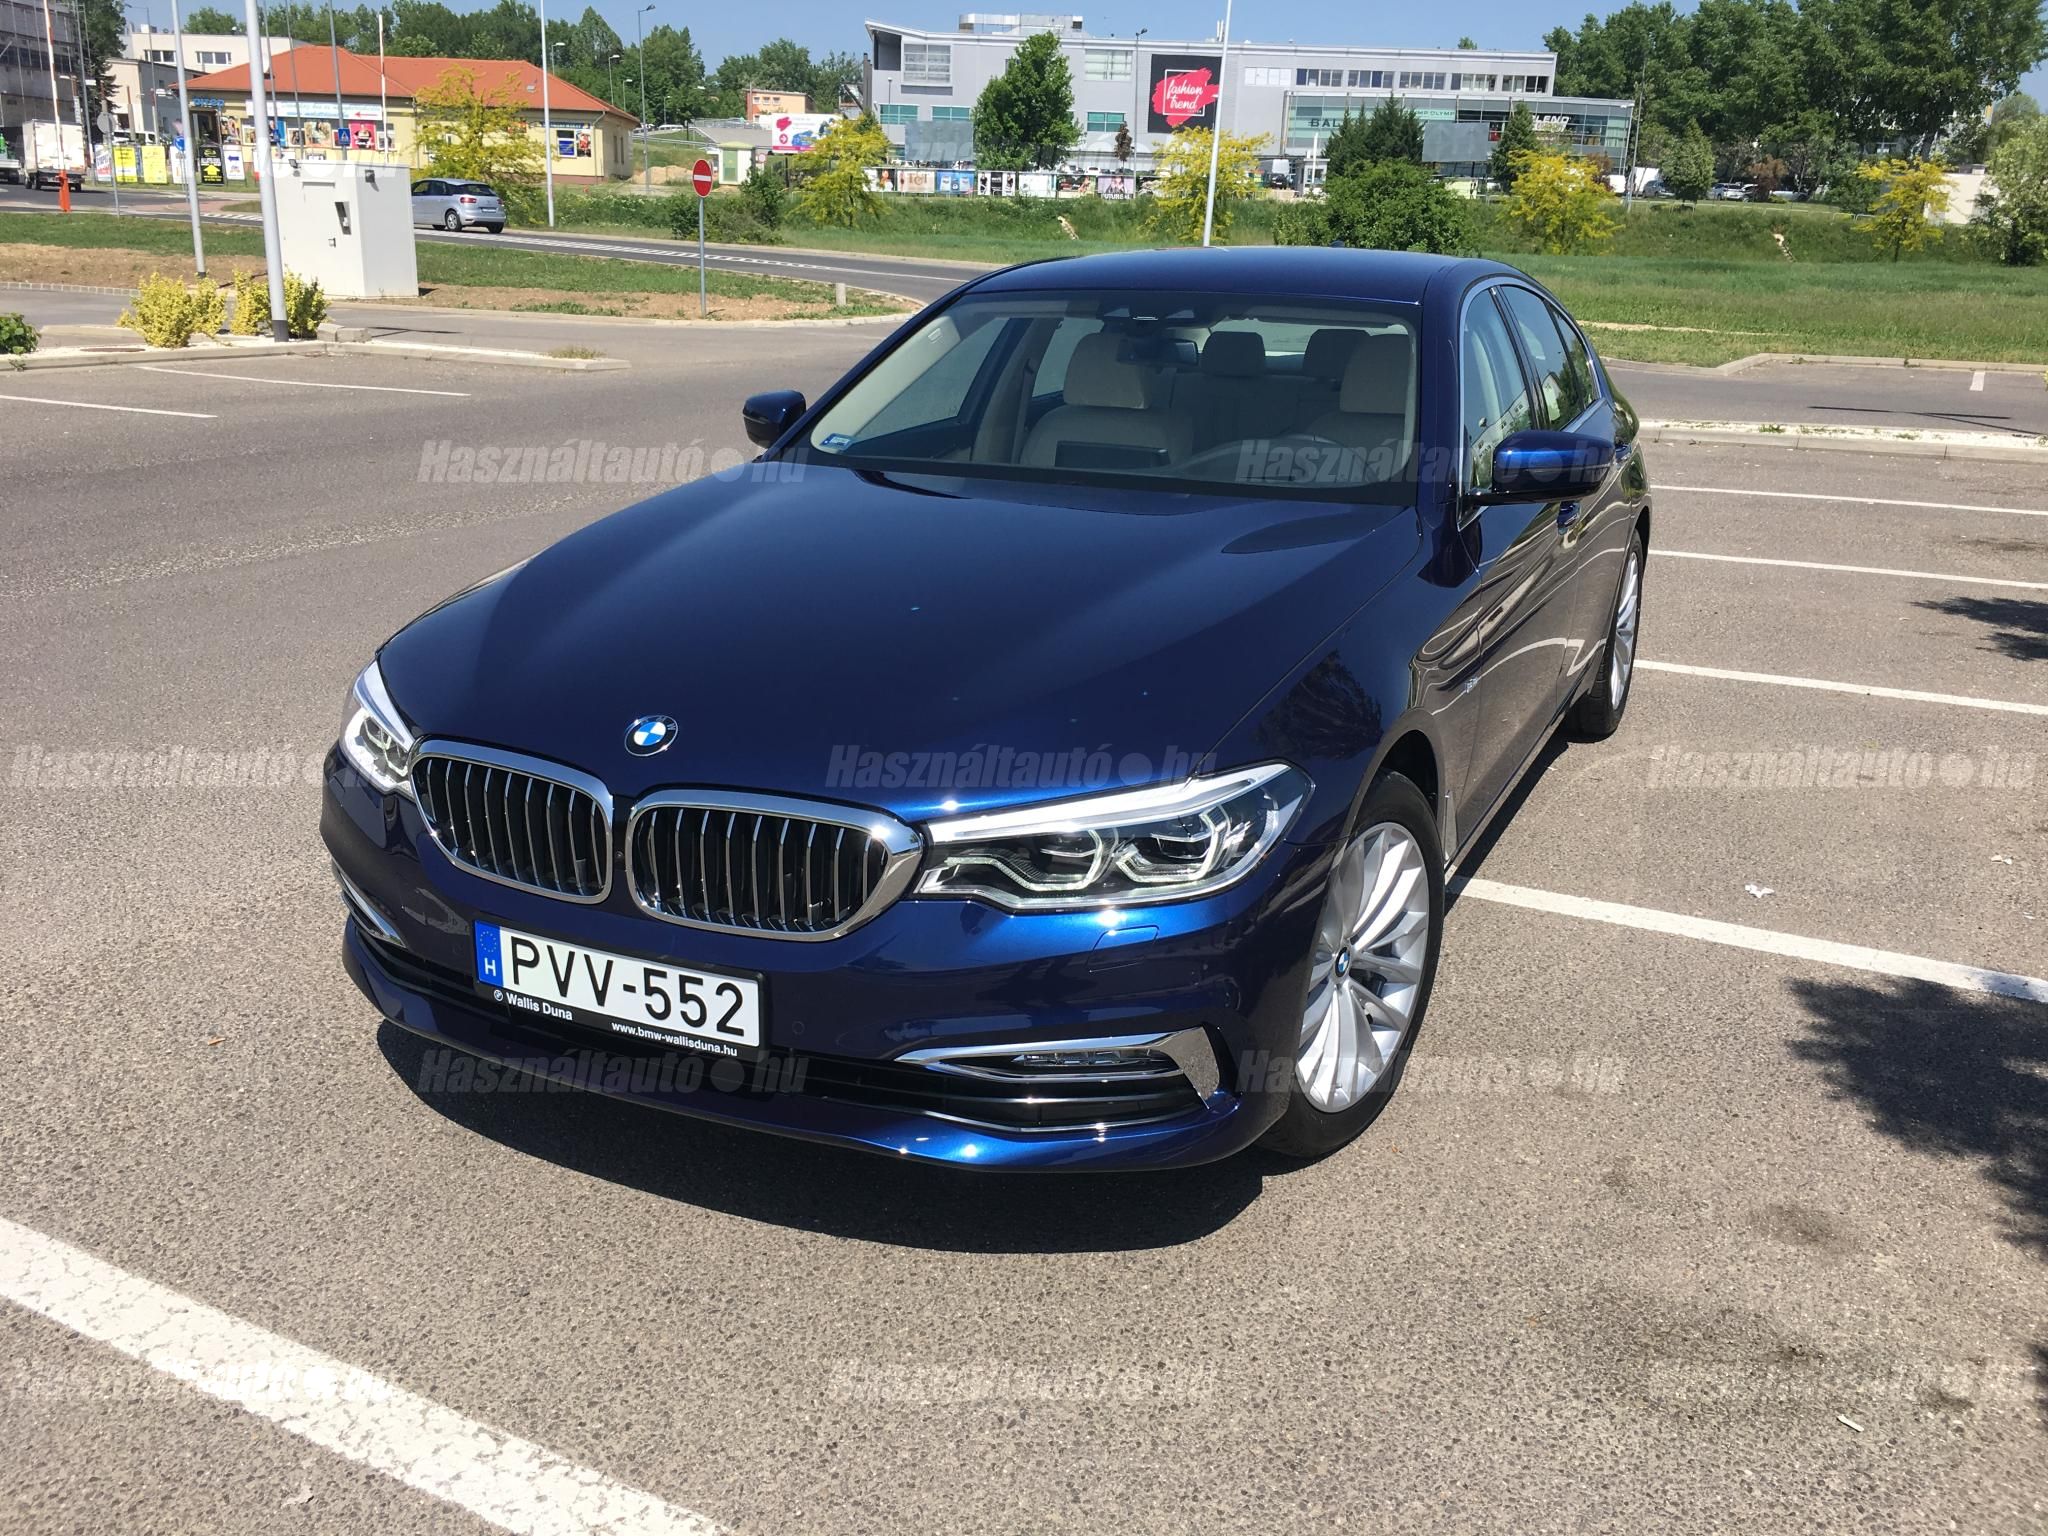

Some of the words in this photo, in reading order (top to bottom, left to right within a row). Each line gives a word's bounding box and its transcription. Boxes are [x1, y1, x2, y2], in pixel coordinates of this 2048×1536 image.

[1167, 79, 1203, 99] fashion
[1170, 95, 1199, 109] trend
[484, 957, 497, 977] H
[510, 936, 745, 1037] PVV-552
[506, 992, 540, 1012] Wallis
[542, 1002, 573, 1021] Duna
[611, 1021, 738, 1057] www.bmw-wallisduna.hu
